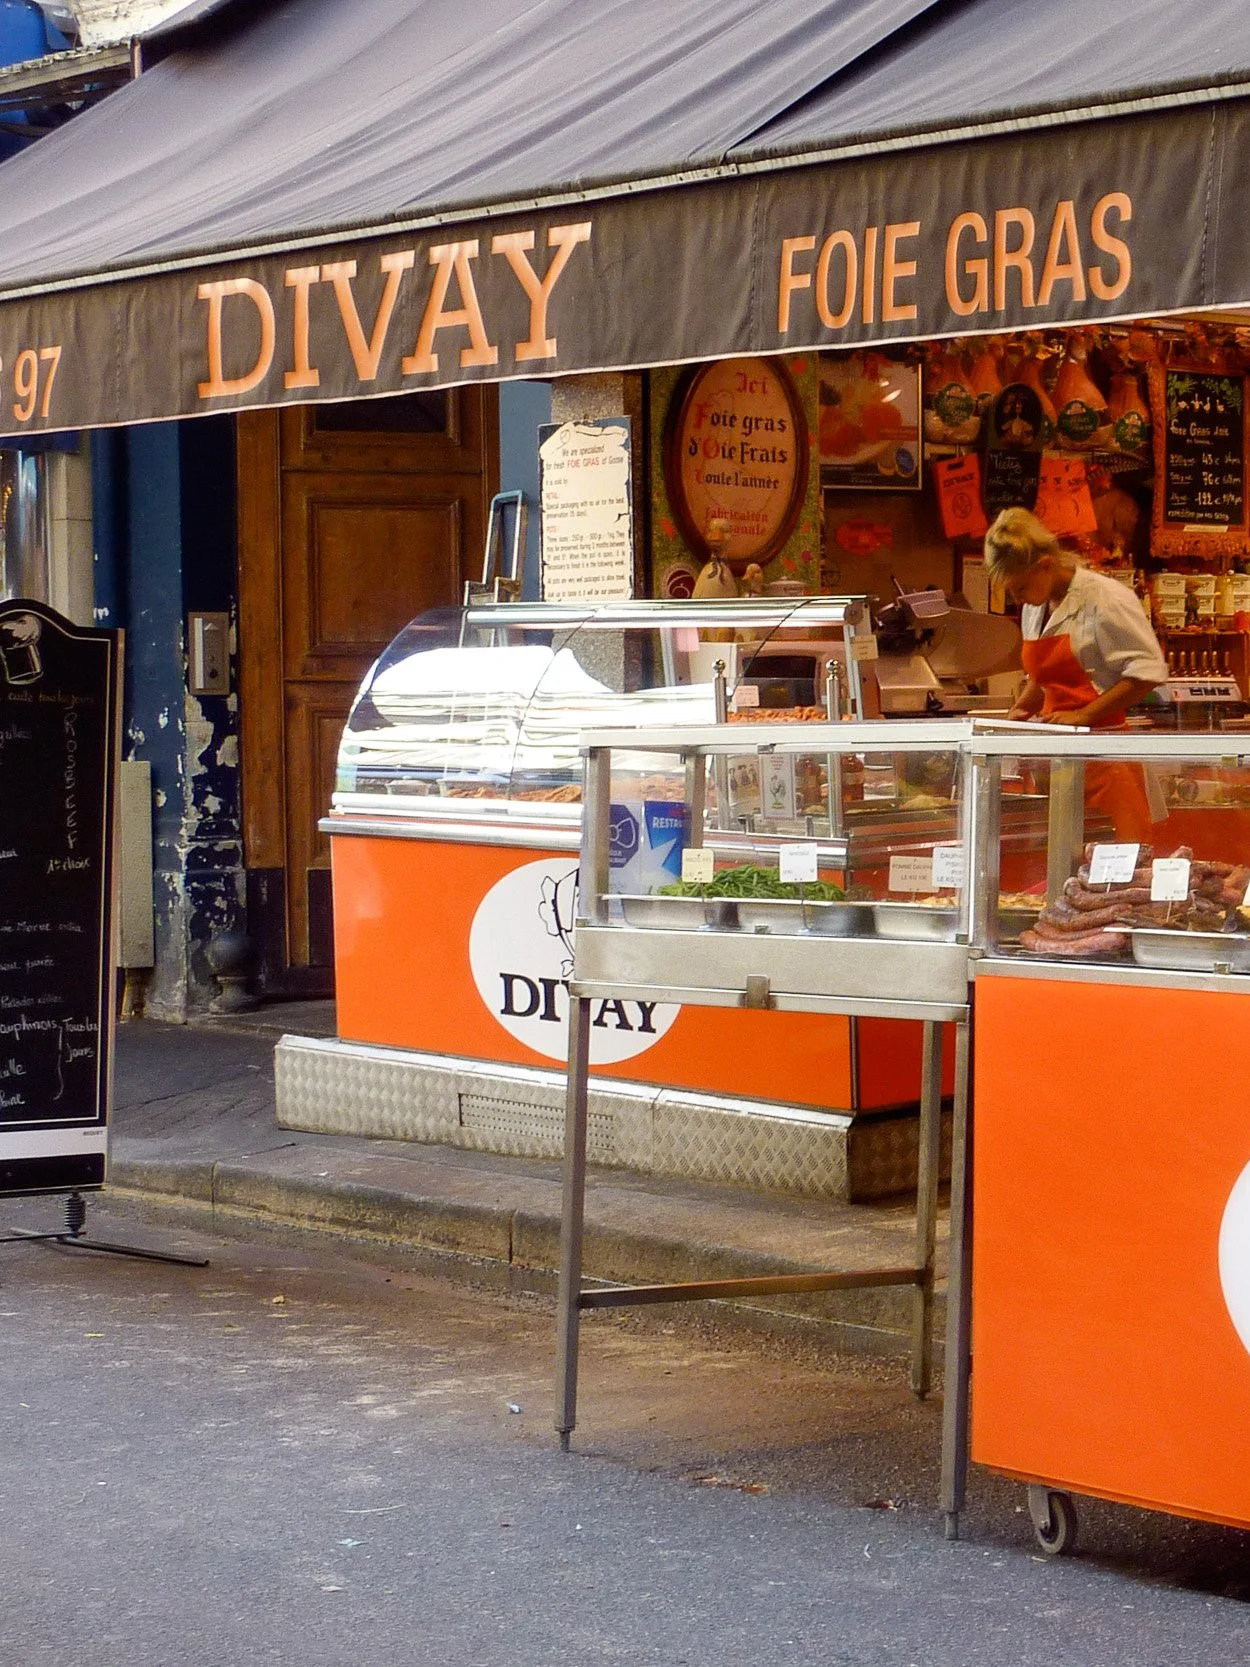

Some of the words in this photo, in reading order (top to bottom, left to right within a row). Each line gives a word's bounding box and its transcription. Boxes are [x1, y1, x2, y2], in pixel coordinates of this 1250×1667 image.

[778, 220, 922, 333] FOIE
[944, 191, 1133, 316] GRAS
[197, 222, 592, 398] DIVAY
[14, 346, 62, 422] 97
[694, 402, 737, 430] Foie
[742, 415, 787, 437] gras
[567, 459, 580, 468] FOIE
[582, 457, 600, 467] GRAS
[500, 972, 657, 1034] DIAY
